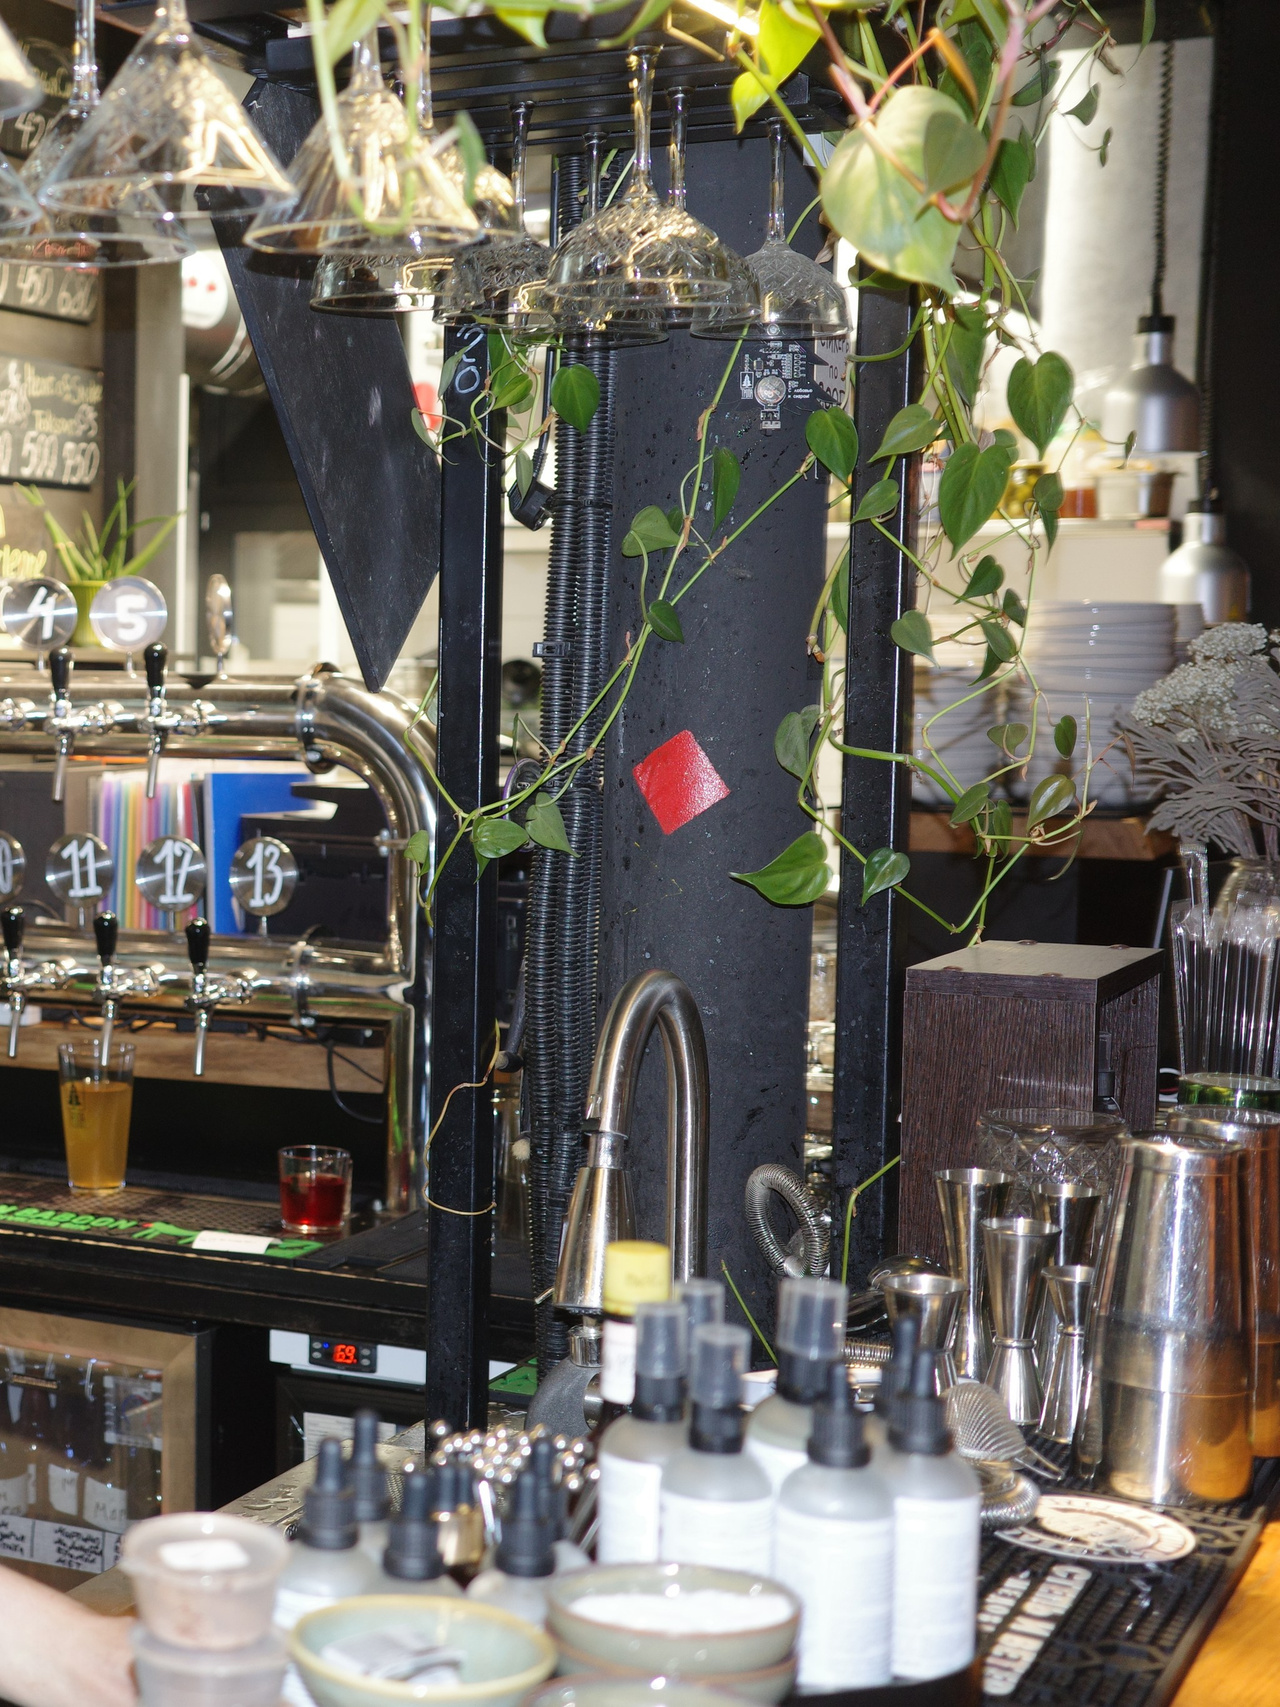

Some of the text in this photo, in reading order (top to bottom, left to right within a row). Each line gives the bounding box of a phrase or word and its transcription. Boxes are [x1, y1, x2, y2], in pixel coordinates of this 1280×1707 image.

[829, 365, 838, 380] по
[27, 586, 58, 639] 4
[116, 593, 148, 640] 5
[61, 835, 102, 898] 11
[153, 838, 191, 904] 12
[247, 843, 283, 908] 13
[14, 1207, 138, 1229] BABOON
[1023, 1564, 1093, 1619] СТЕПЬ
[982, 1632, 1048, 1696] ВЕТЕР
